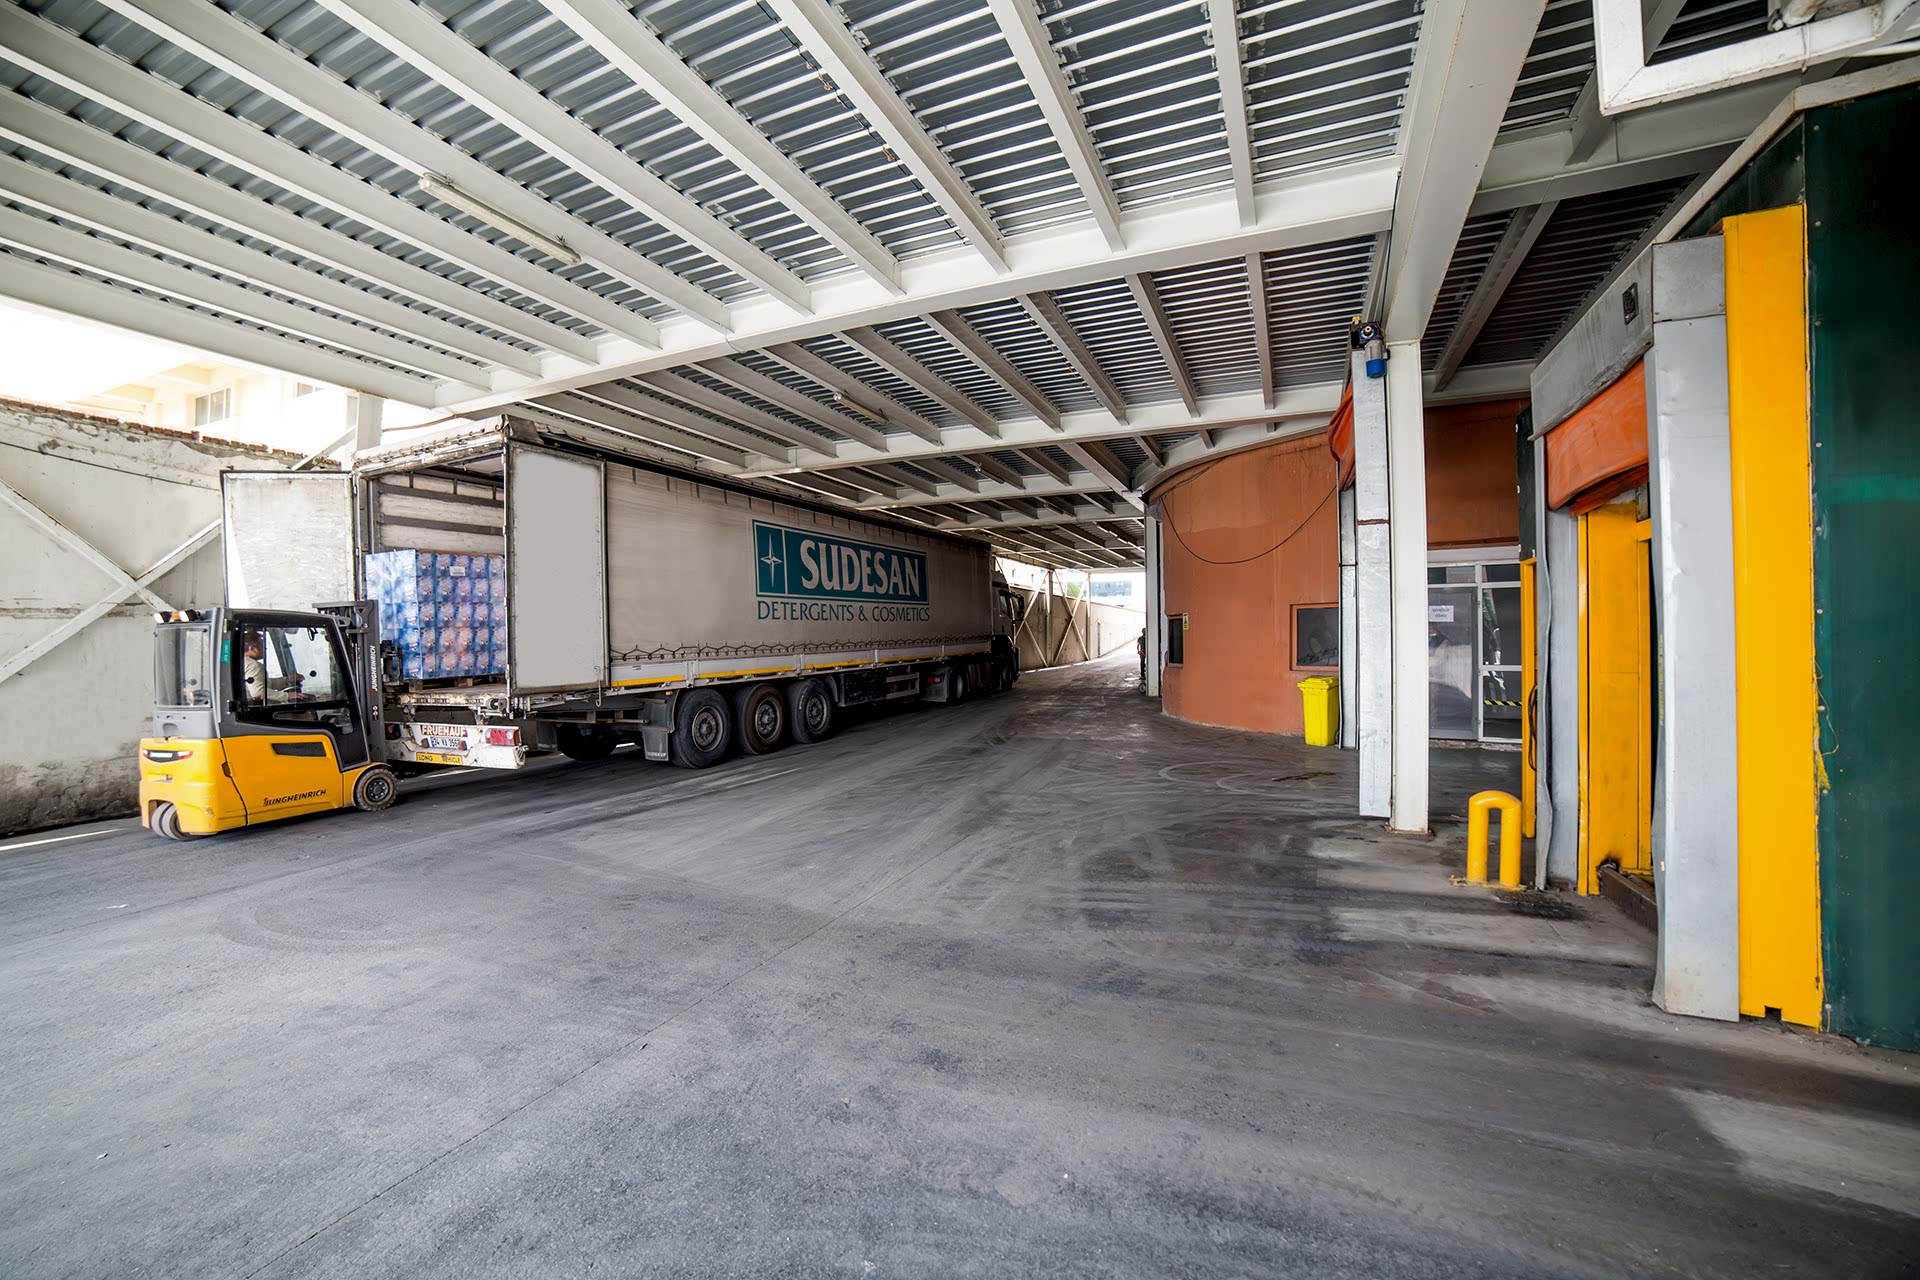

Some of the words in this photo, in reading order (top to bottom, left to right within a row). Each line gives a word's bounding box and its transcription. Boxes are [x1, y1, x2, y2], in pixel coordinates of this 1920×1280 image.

[800, 539, 920, 598] SUDESAN
[757, 600, 854, 622] DETERGENTS
[858, 605, 868, 622] &
[872, 606, 930, 622] COSMETICS
[422, 725, 466, 737] FRUEHAUF
[418, 754, 433, 762] LONG
[442, 754, 460, 763] VEHICLE
[264, 789, 327, 806] JUNGHEINRICH
